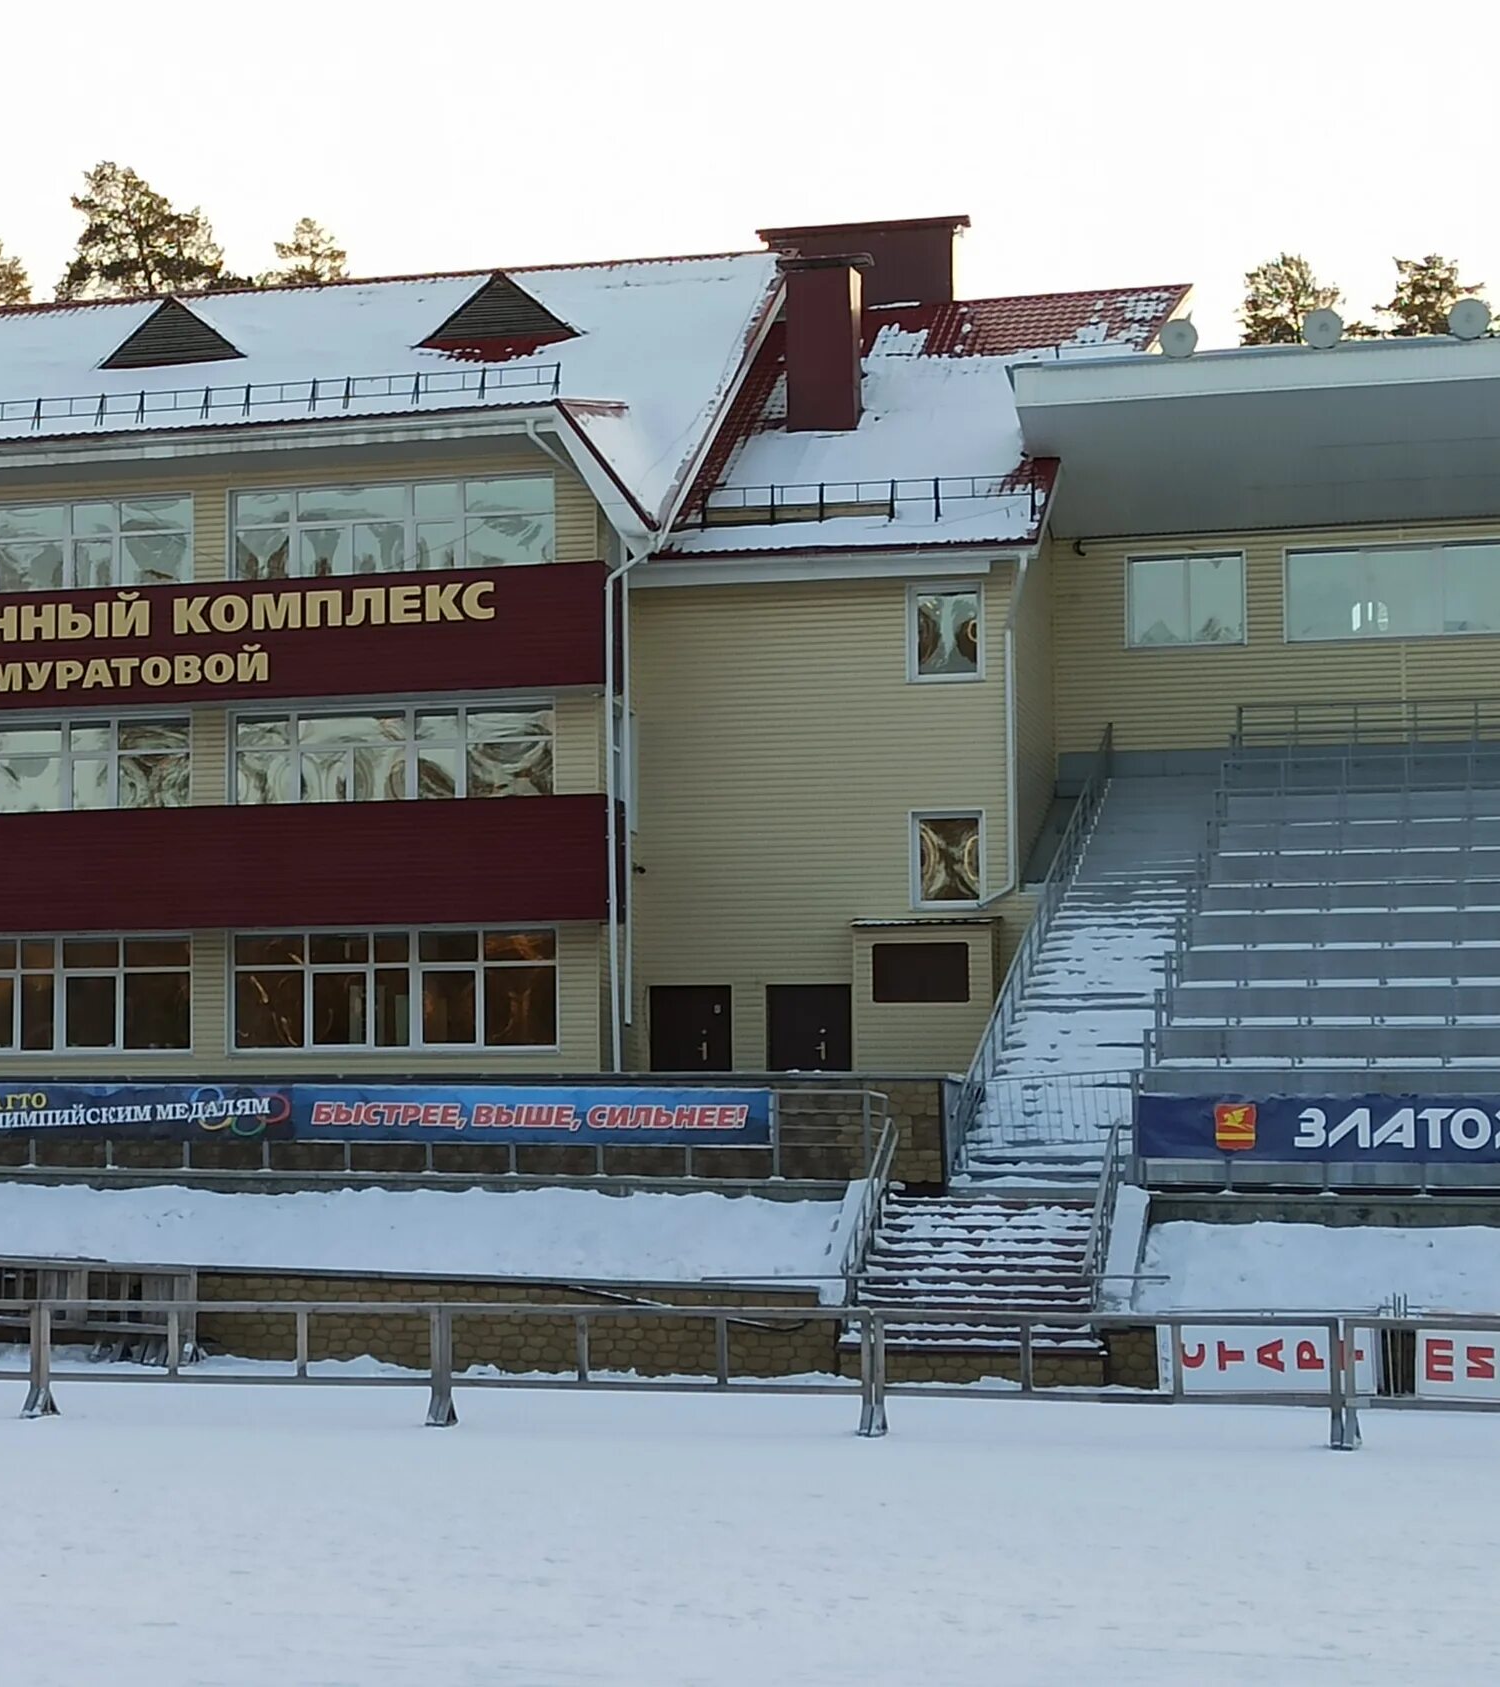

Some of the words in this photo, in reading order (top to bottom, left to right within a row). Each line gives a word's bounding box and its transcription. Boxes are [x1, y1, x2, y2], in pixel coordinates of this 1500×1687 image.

[173, 581, 496, 635] КОМПЛЕКС
[4, 1092, 47, 1111] ГТО
[156, 1098, 271, 1123] МЕДАЛЯМ
[311, 1102, 467, 1128] БЫСТРЕЕ,
[472, 1103, 580, 1131] ВЫШЕ,
[587, 1104, 749, 1130] СИЛЬНЕЕ!
[1294, 1107, 1500, 1150] ЗЛАТО
